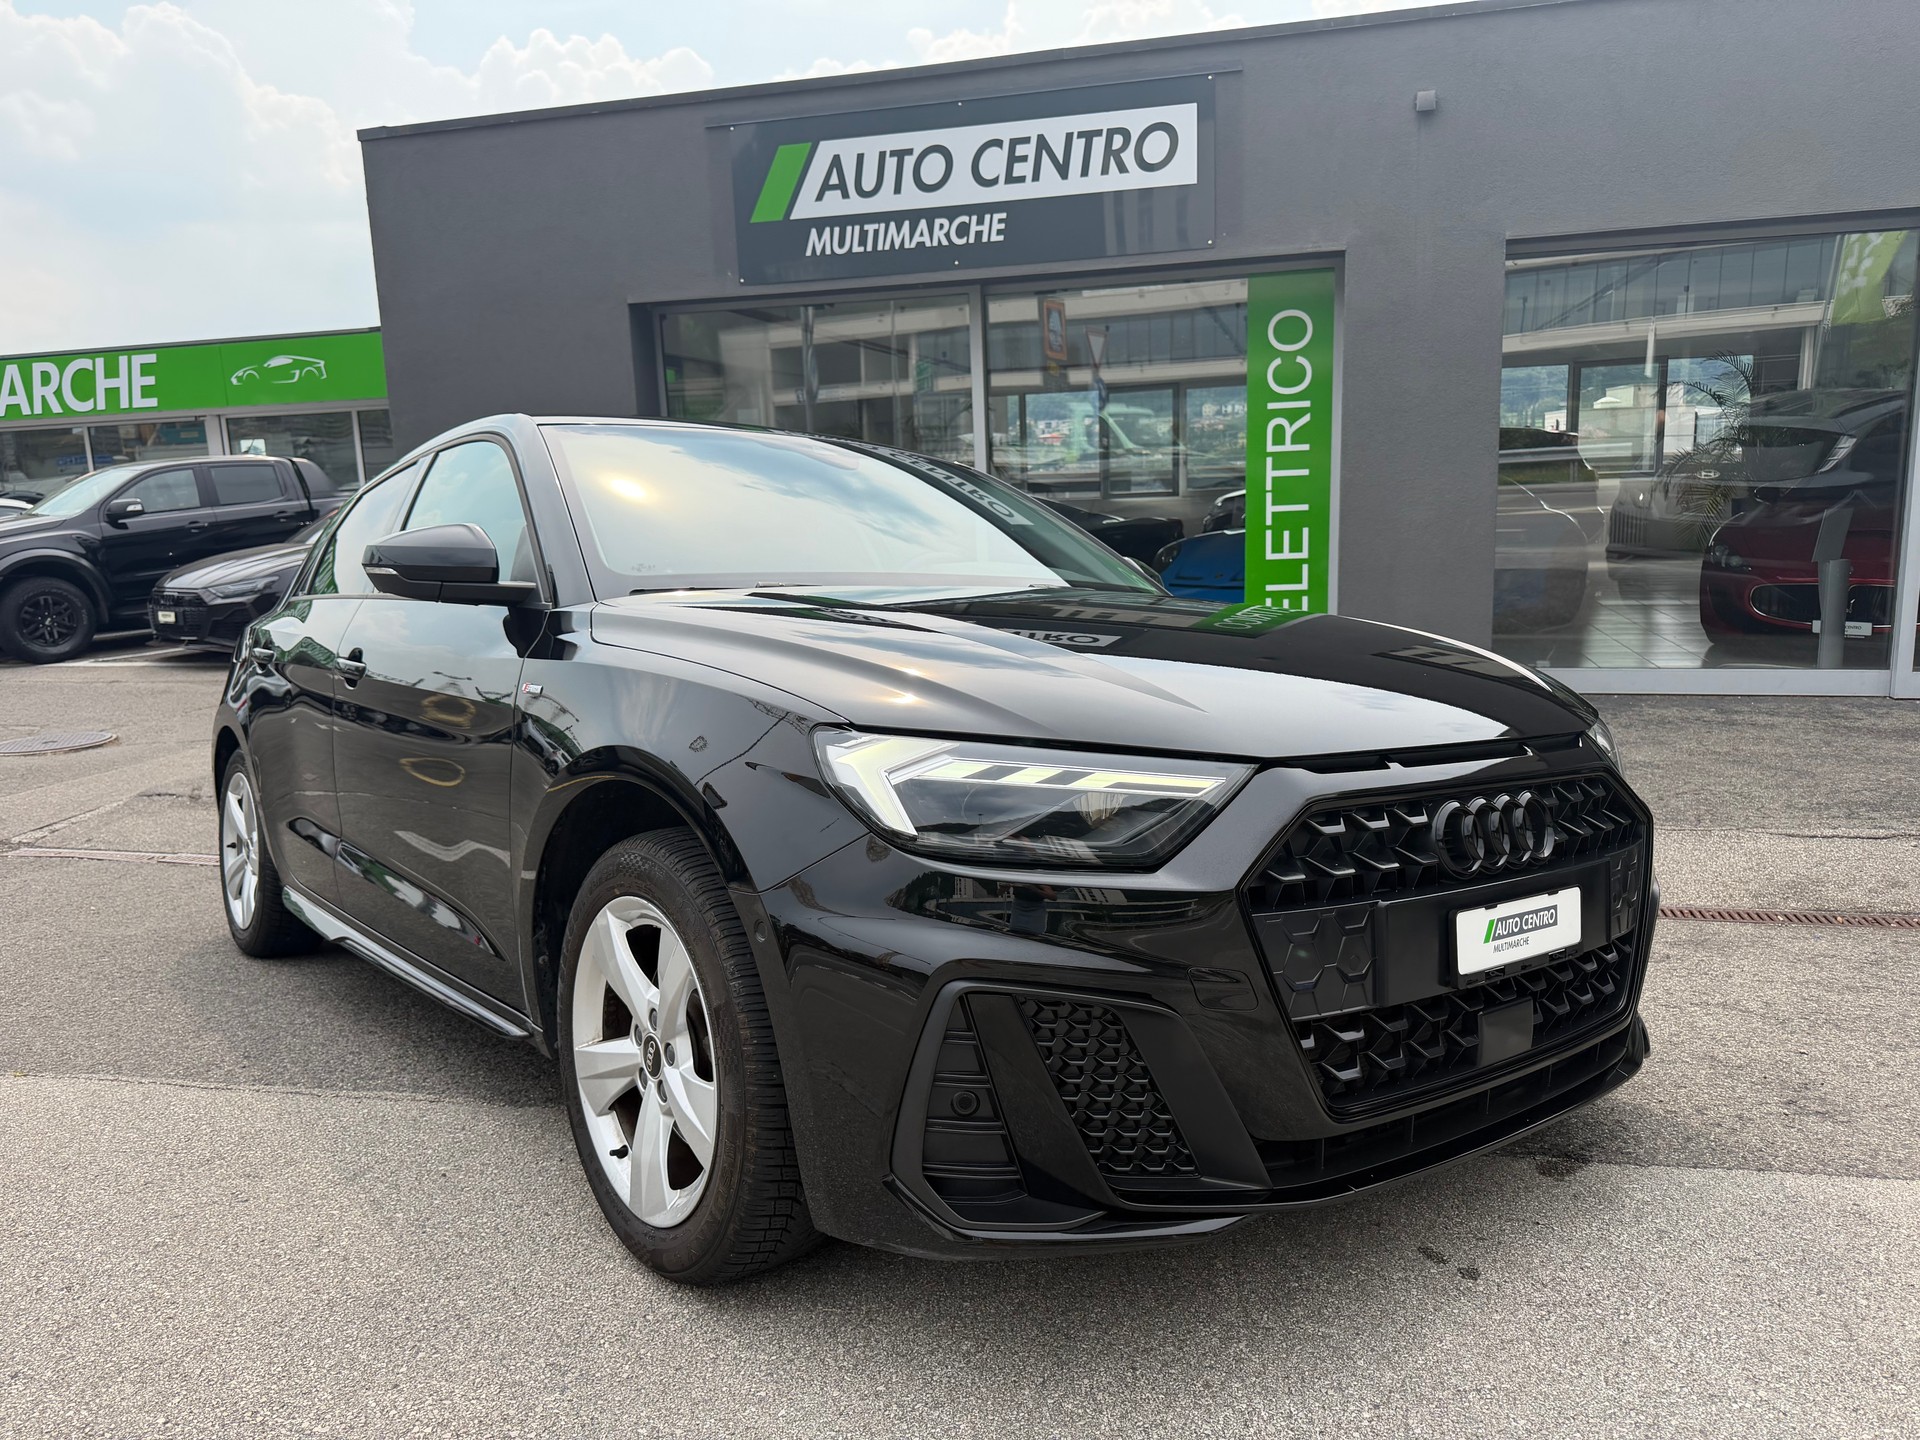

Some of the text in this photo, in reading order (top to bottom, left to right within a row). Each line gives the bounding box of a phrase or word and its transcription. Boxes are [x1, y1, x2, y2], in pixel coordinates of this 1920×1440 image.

[814, 121, 1180, 202] AUTO CENTRO
[805, 212, 1007, 257] MULTIMARCHE
[0, 353, 159, 417] ARCHE
[1492, 936, 1530, 954] MULTIMARCHE
[1495, 908, 1556, 937] AUTO CENTRO
